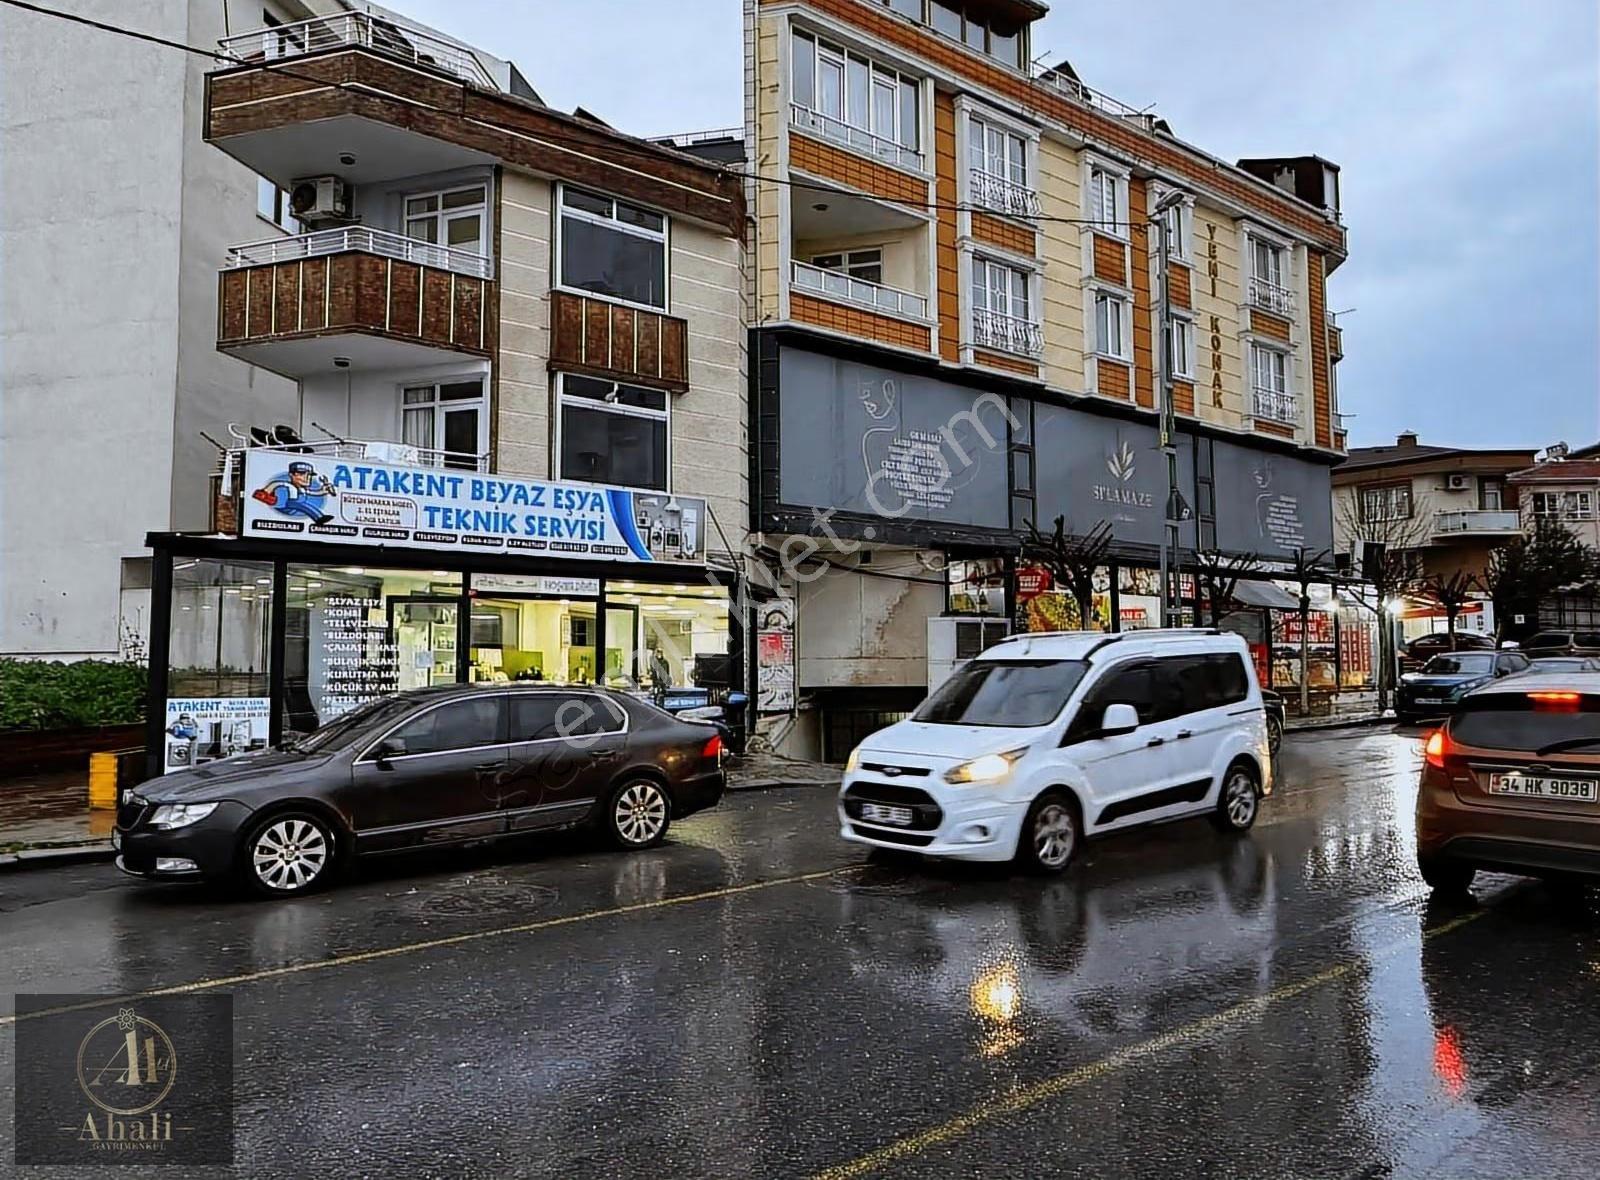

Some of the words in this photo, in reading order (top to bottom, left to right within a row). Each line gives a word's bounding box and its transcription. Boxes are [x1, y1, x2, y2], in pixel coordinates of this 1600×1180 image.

[1210, 315, 1222, 409] KONAK
[333, 464, 463, 500] ATAKENT
[471, 479, 546, 508] BEYAZ
[553, 487, 605, 516] EŞYA
[424, 503, 518, 534] TEKNİK
[524, 513, 606, 541] SERVİSİ
[328, 631, 385, 640] BUZDOLABI
[326, 670, 379, 680] KURUTMA
[326, 682, 362, 693] KÜÇÜK
[168, 701, 222, 712] ATAKENT
[1501, 777, 1519, 792] 34
[1525, 779, 1544, 794] HK
[1550, 780, 1590, 797] 9038
